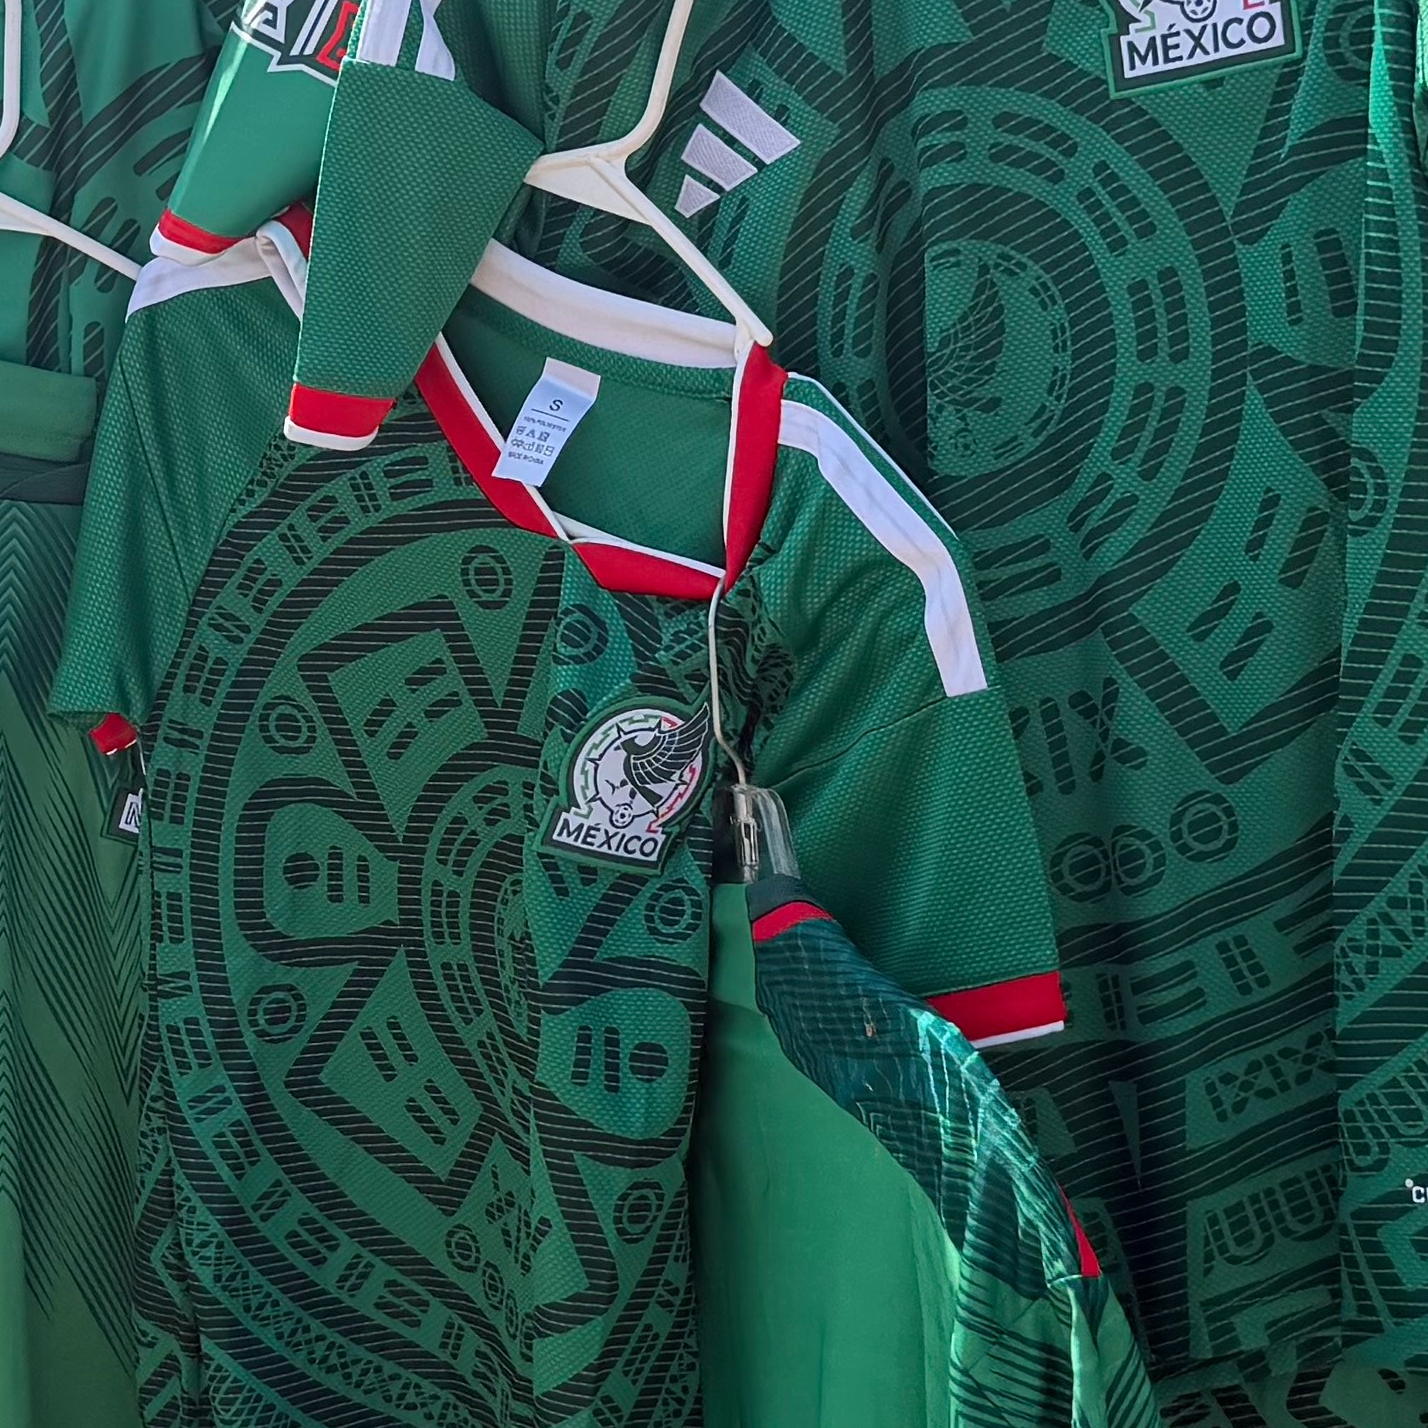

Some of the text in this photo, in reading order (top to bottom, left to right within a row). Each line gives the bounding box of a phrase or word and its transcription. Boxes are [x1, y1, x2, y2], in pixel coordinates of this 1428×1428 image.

[1126, 10, 1277, 72] MÉXICO
[548, 398, 564, 412] S
[556, 817, 659, 858] MÉXICO
